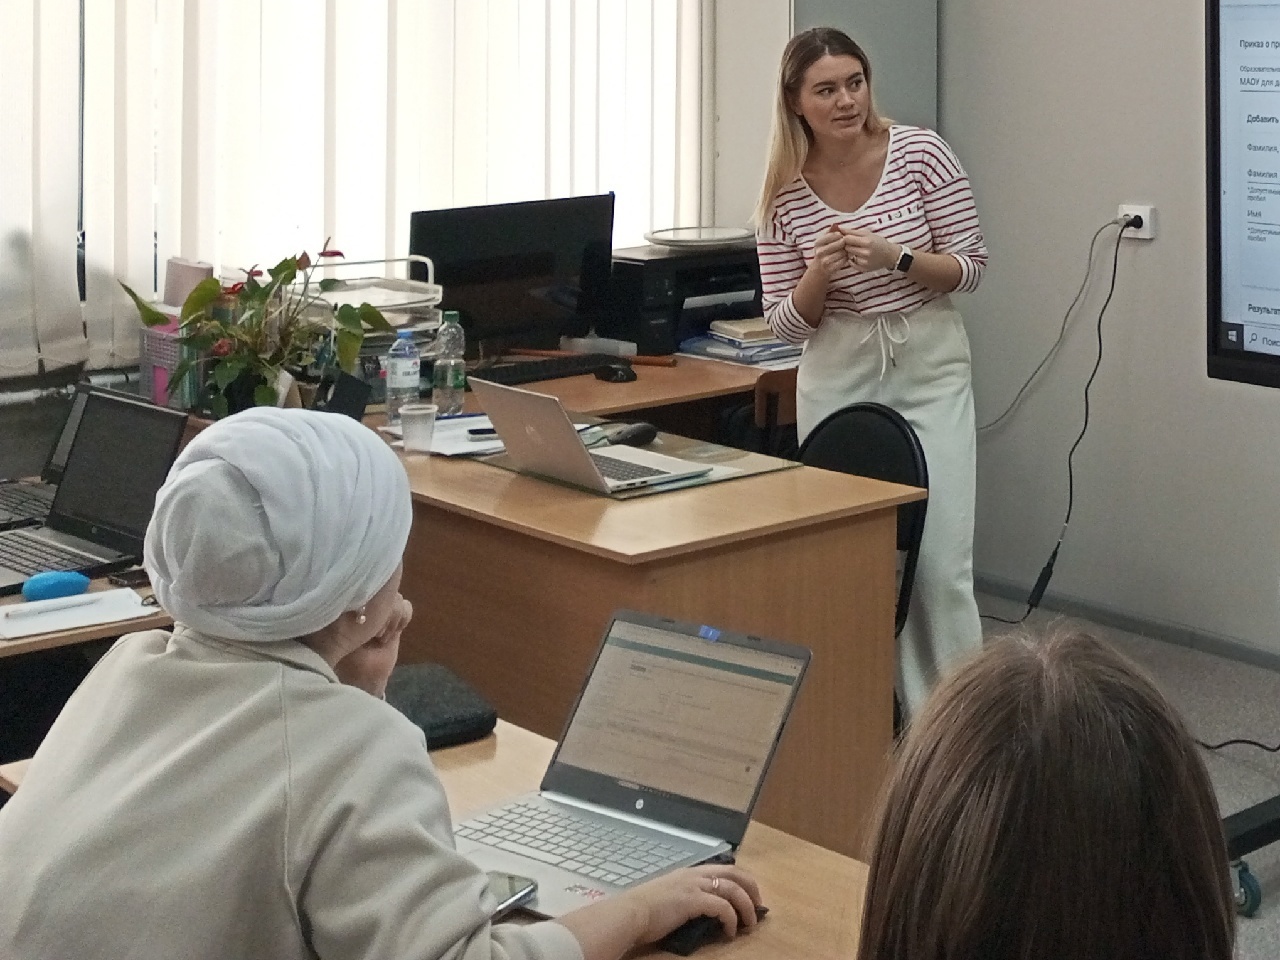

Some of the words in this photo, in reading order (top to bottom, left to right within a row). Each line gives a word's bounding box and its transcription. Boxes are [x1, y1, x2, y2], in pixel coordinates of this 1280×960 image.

[1239, 40, 1264, 50] Приказ
[1239, 77, 1260, 86] МАОУ
[1261, 79, 1273, 88] для
[1246, 114, 1279, 124] Добавить
[1247, 168, 1278, 178] Фамилия
[1247, 209, 1262, 218] Имя
